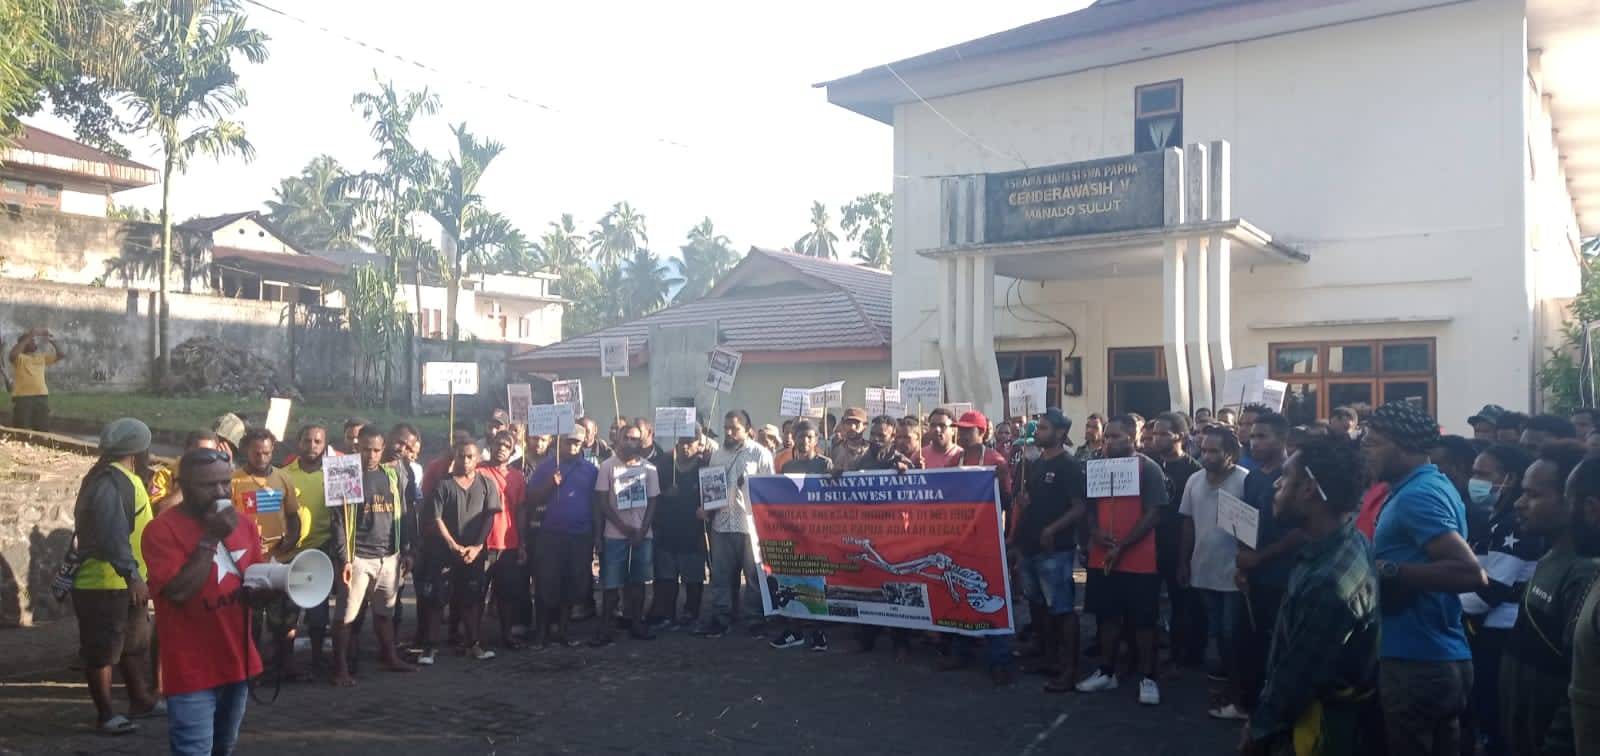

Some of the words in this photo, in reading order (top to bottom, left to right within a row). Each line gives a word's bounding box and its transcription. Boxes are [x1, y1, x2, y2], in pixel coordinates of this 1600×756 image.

[1104, 162, 1138, 177] PAPUA
[1008, 181, 1113, 206] CENDERAWASIH
[1024, 205, 1075, 220] MANADO
[1079, 199, 1122, 215] SULUT
[819, 475, 877, 488] RAKYAT
[879, 473, 927, 486] PAPUA
[807, 491, 821, 502] DI
[824, 489, 893, 502] SULAWESI
[896, 488, 945, 501] UTARA
[850, 524, 884, 537] PAPUA
